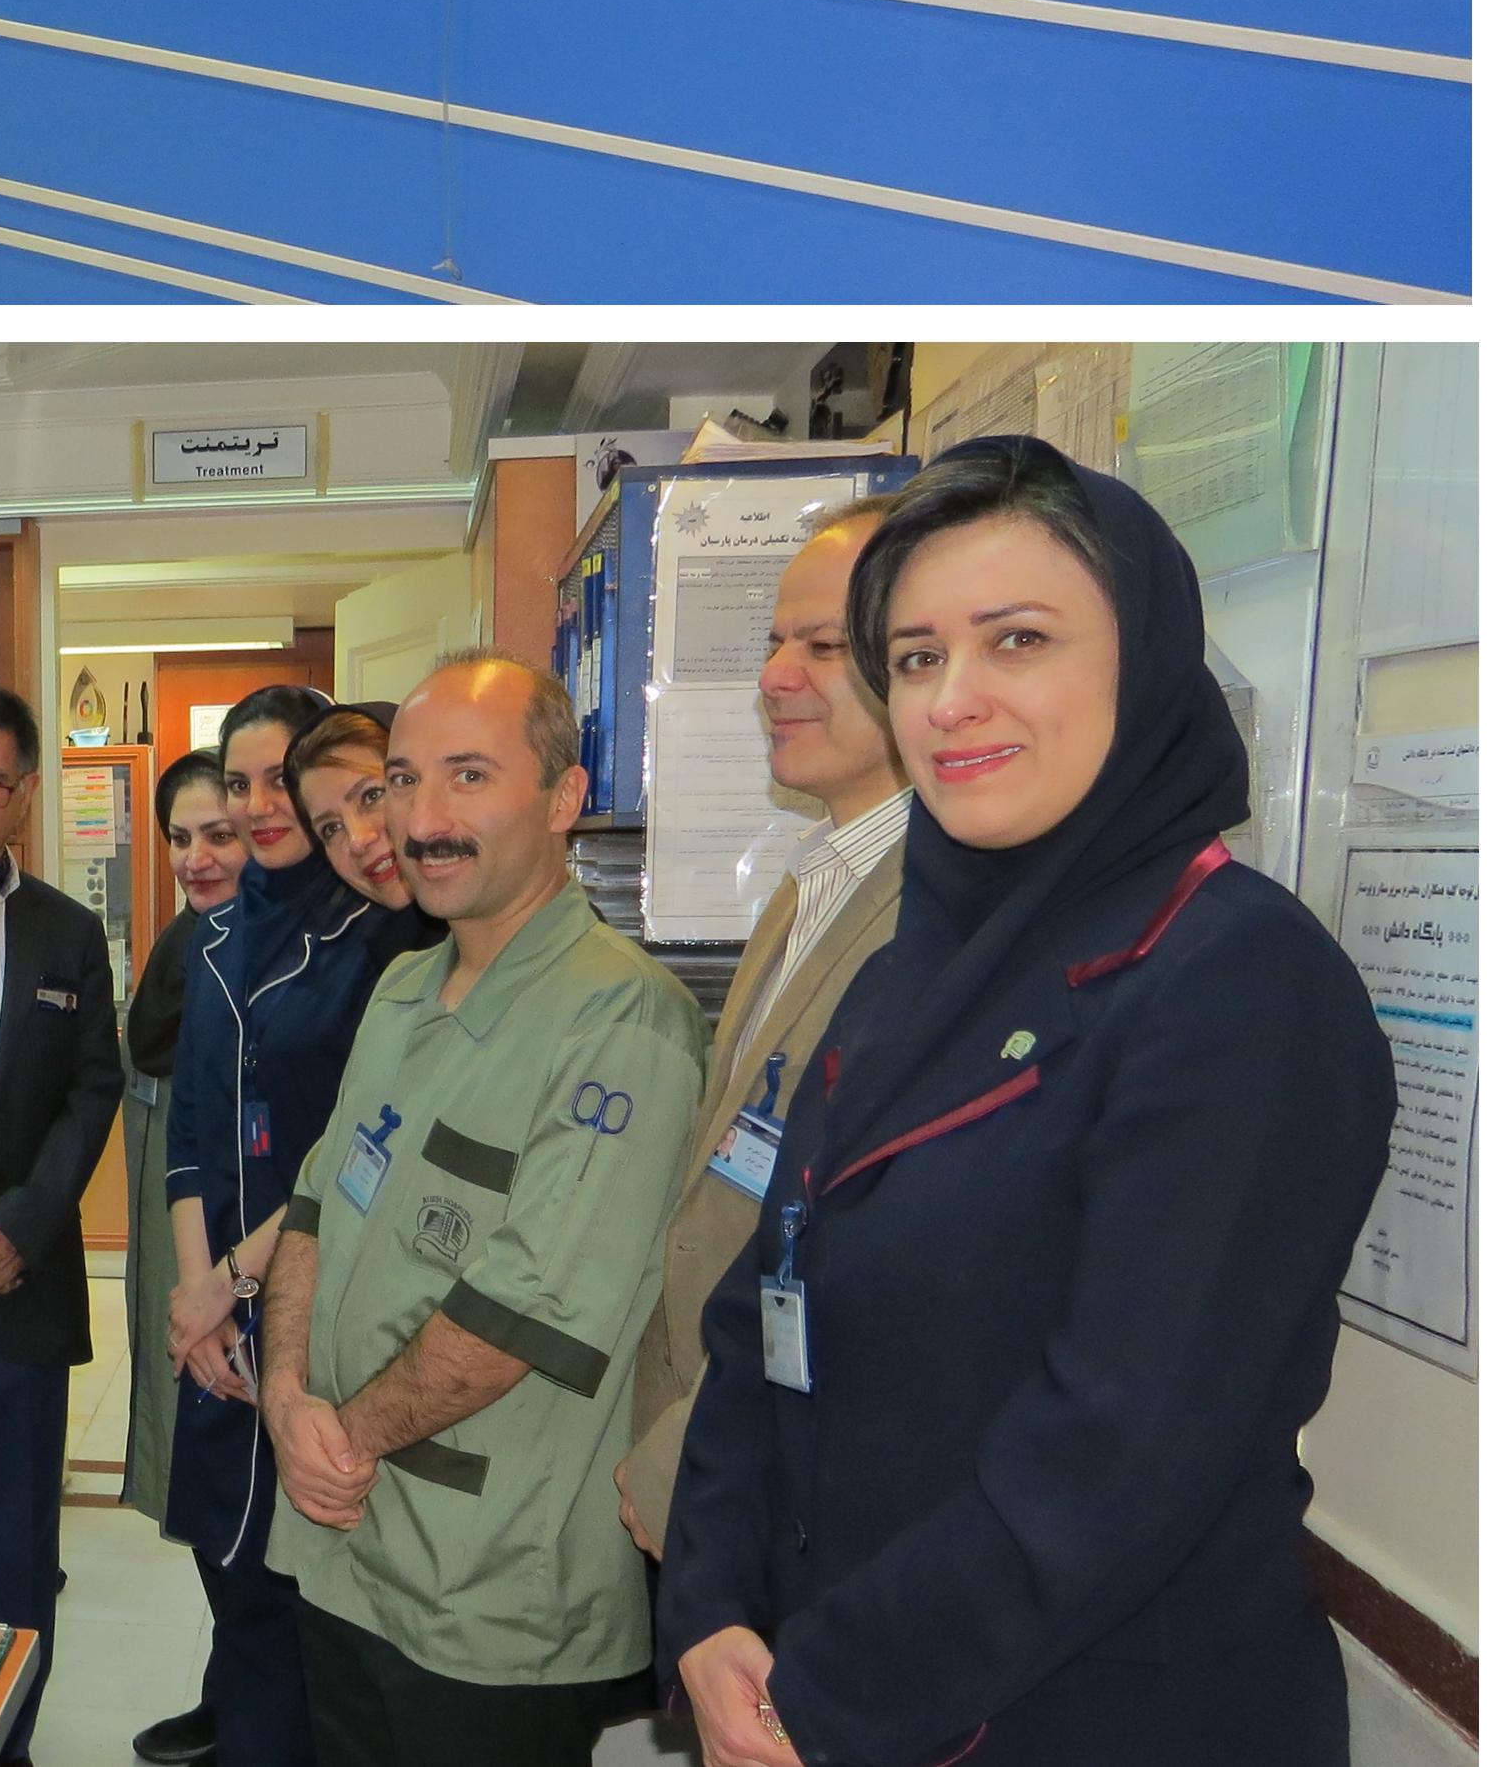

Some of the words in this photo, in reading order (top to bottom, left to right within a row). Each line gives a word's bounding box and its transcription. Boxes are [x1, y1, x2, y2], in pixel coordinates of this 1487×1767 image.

[180, 431, 280, 457] تریتمنت
[195, 465, 264, 478] Treatment
[739, 512, 770, 522] اطلاعیه
[700, 536, 731, 548] پارسیان
[732, 535, 758, 547] درمان
[761, 534, 789, 547] تکمیلی
[1383, 920, 1411, 943] دانش
[1413, 921, 1444, 948] پایگاه
